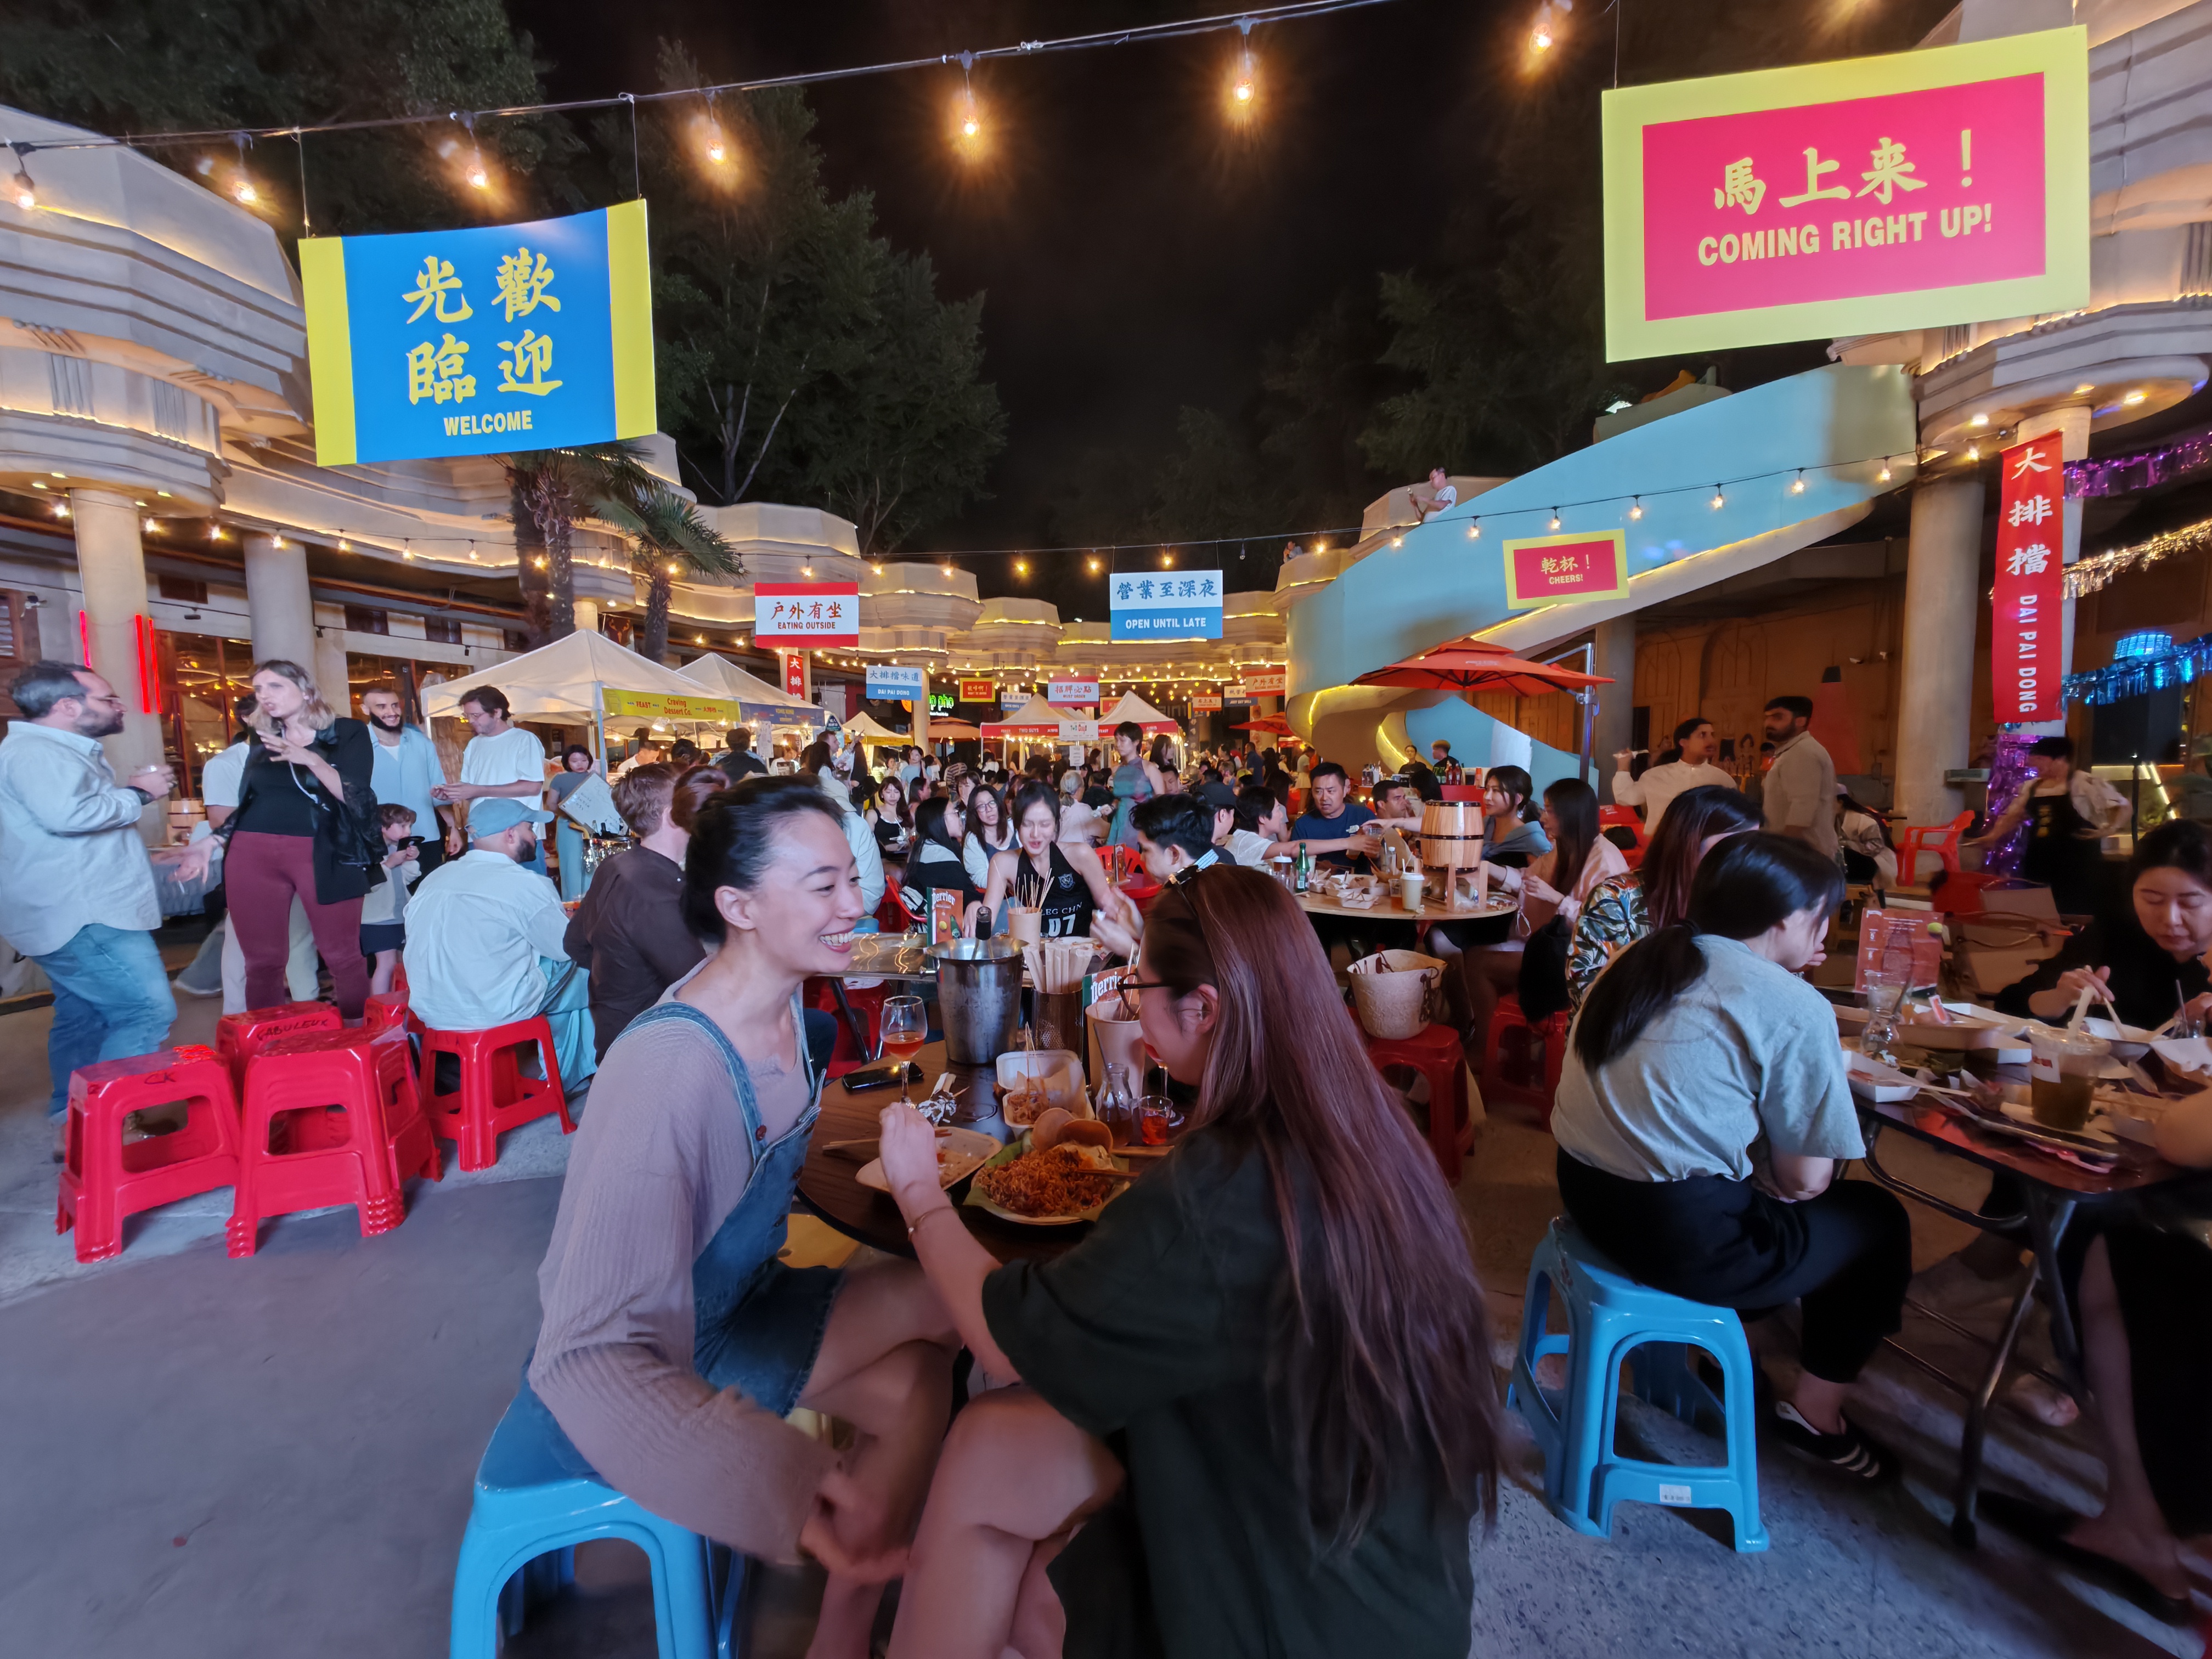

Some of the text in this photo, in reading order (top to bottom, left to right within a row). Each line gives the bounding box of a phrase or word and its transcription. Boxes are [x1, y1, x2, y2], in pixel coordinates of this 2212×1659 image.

[1699, 204, 1993, 266] COMING RIGHT UP!
[443, 409, 533, 437] WELCOME
[1549, 574, 1583, 585] CHEERS!
[1116, 579, 1218, 601] 營業至深夜
[777, 621, 836, 630] EATING OUTSIDE
[1125, 617, 1206, 629] OPEN UNTIL LATE
[2018, 594, 2038, 713] DAI PAI DONG
[667, 698, 687, 708] Craving
[664, 707, 683, 716] Dessert
[1062, 901, 1082, 915] CHN
